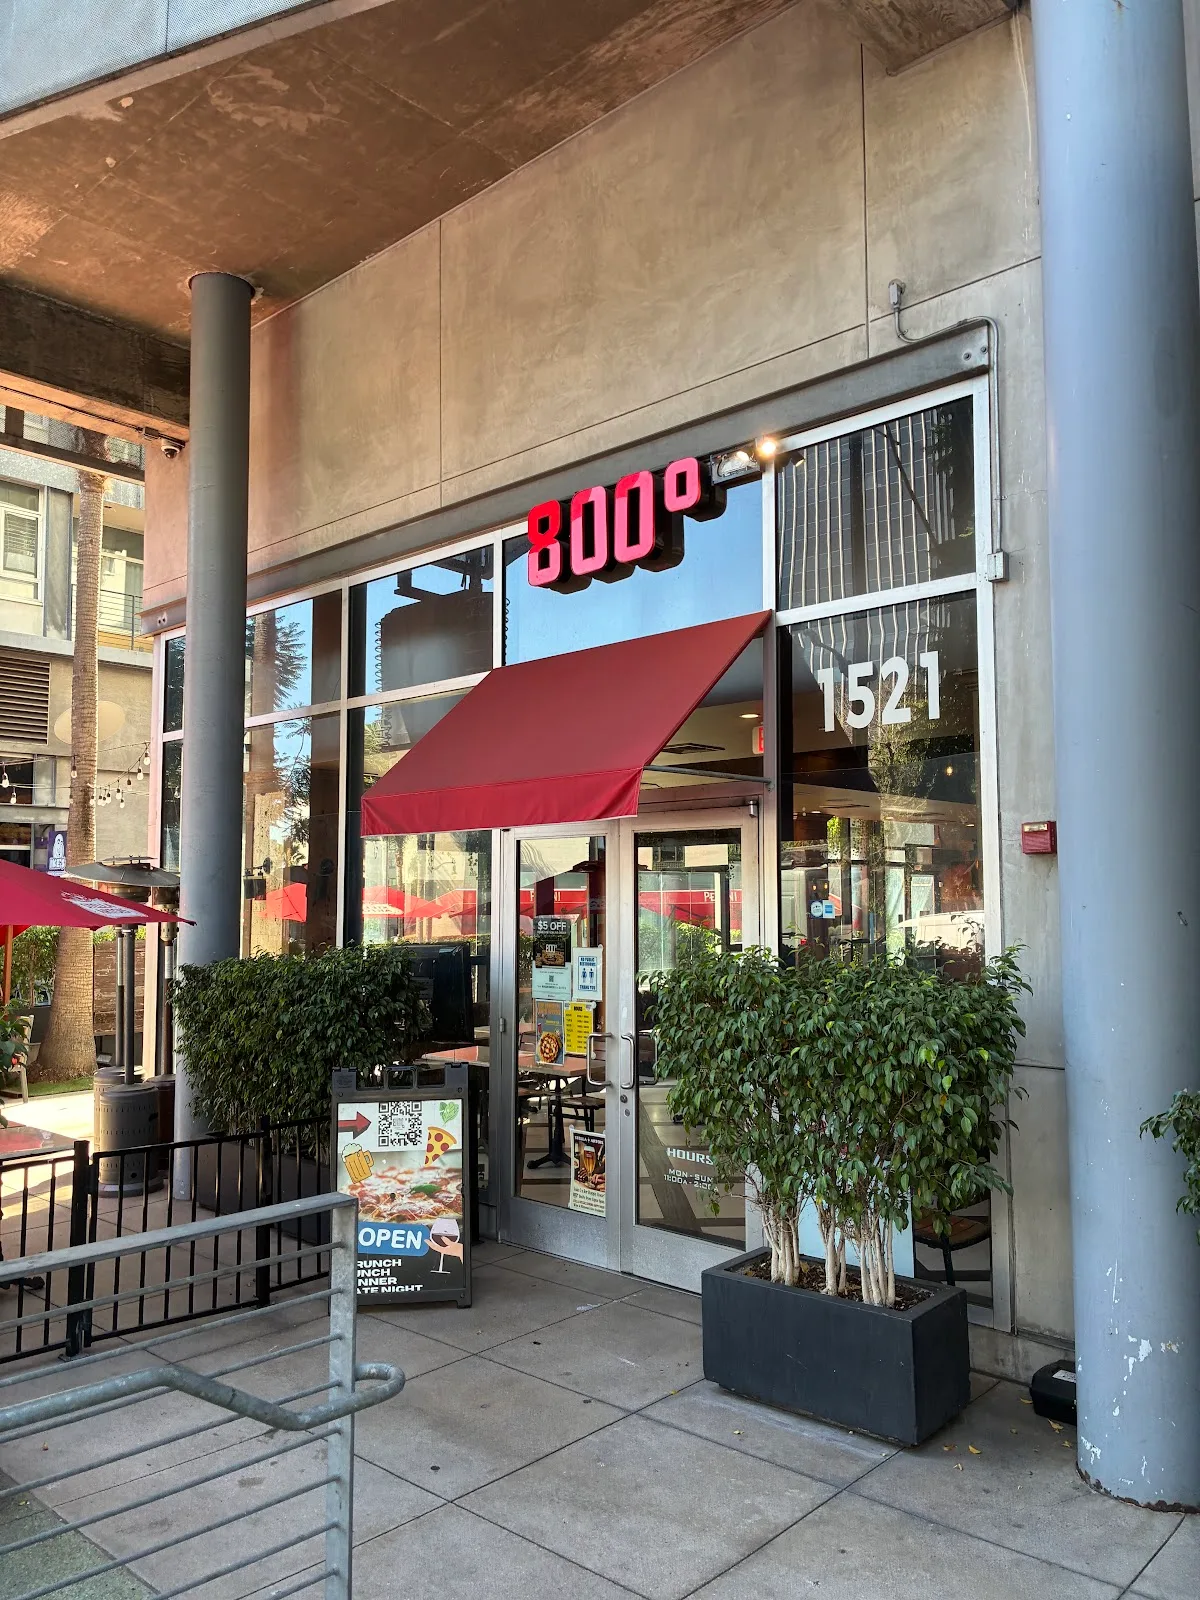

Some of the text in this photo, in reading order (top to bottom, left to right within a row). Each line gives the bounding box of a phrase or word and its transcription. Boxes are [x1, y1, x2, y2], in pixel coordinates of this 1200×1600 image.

[817, 650, 941, 733] 1521
[537, 920, 567, 931] $5 OFF
[666, 1147, 714, 1165] HOURS
[668, 1169, 688, 1178] MON
[694, 1173, 713, 1183] SUN
[358, 1227, 423, 1250] OPEN
[357, 1259, 402, 1269] RUNCH
[357, 1277, 398, 1287] NNER
[381, 1284, 424, 1293] NIGHT
